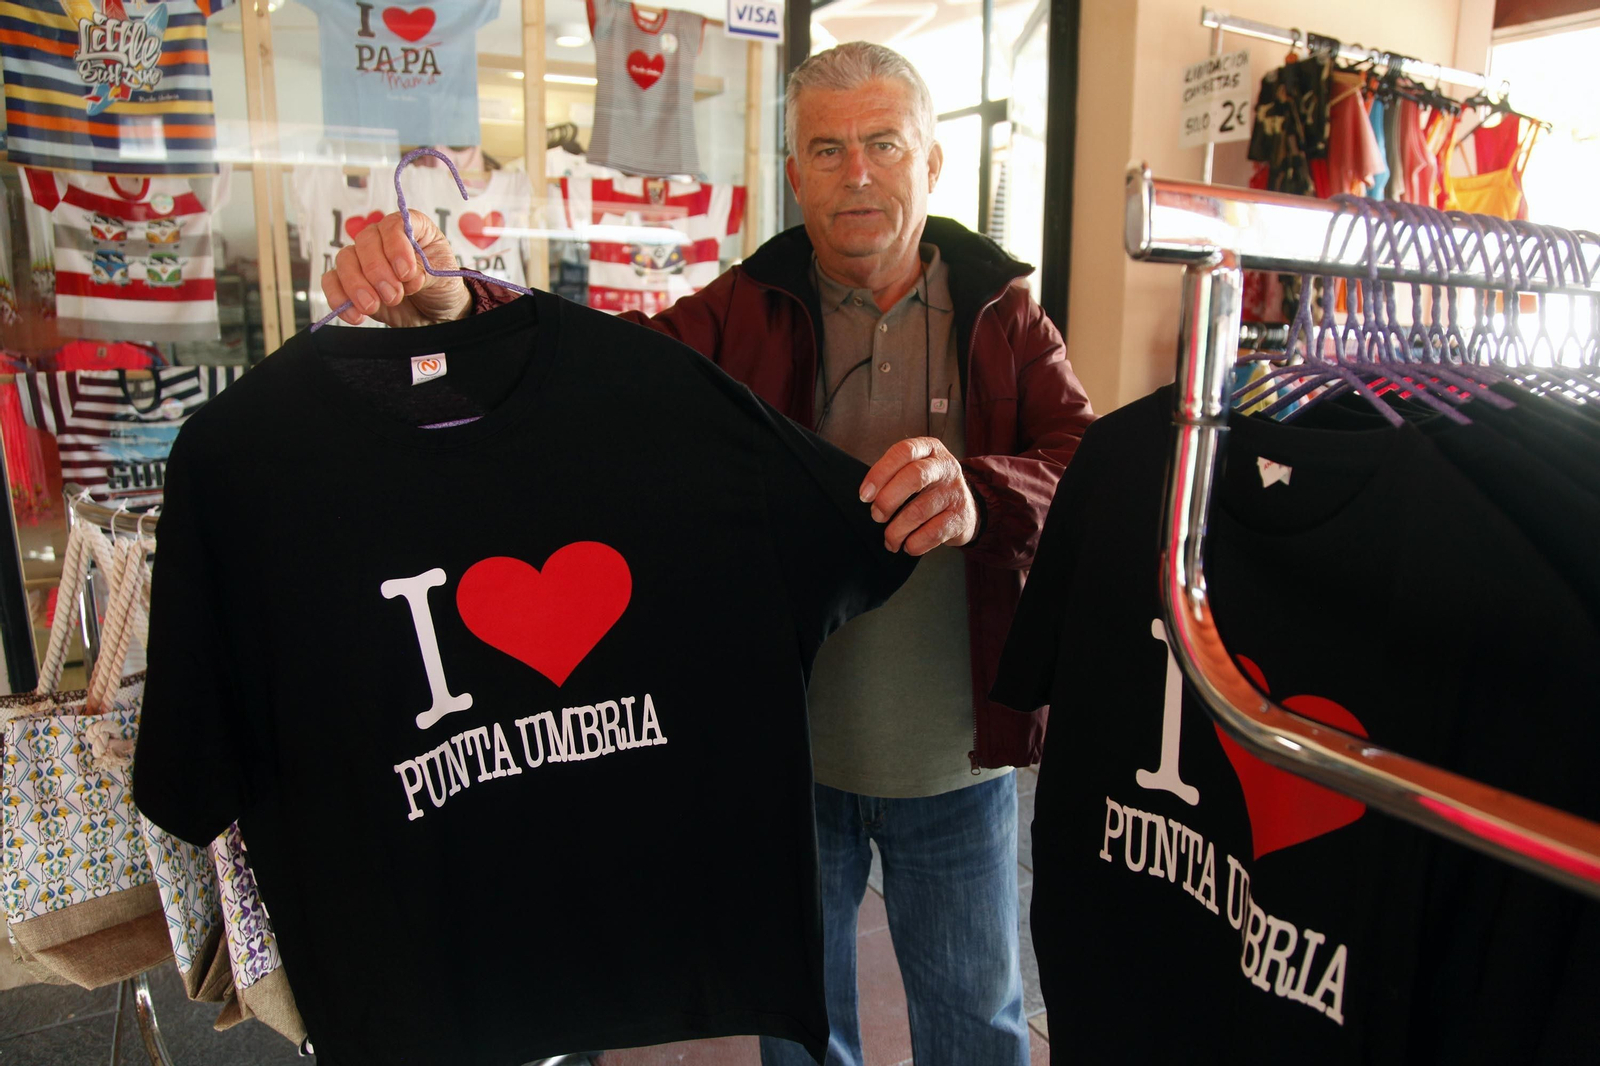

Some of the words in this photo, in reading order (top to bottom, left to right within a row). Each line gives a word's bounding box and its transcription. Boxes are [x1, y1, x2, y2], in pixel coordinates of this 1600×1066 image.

[76, 12, 162, 69] Little
[356, 2, 375, 38] I
[736, 4, 778, 25] VISA
[355, 44, 441, 75] PAPA
[1219, 100, 1249, 133] 2€
[380, 567, 473, 730] I
[1136, 618, 1200, 806] I
[394, 722, 522, 821] PUNTA
[515, 693, 668, 768] UMBRIA
[1099, 796, 1220, 915] PUNTA
[1227, 854, 1348, 1026] UBRIA
